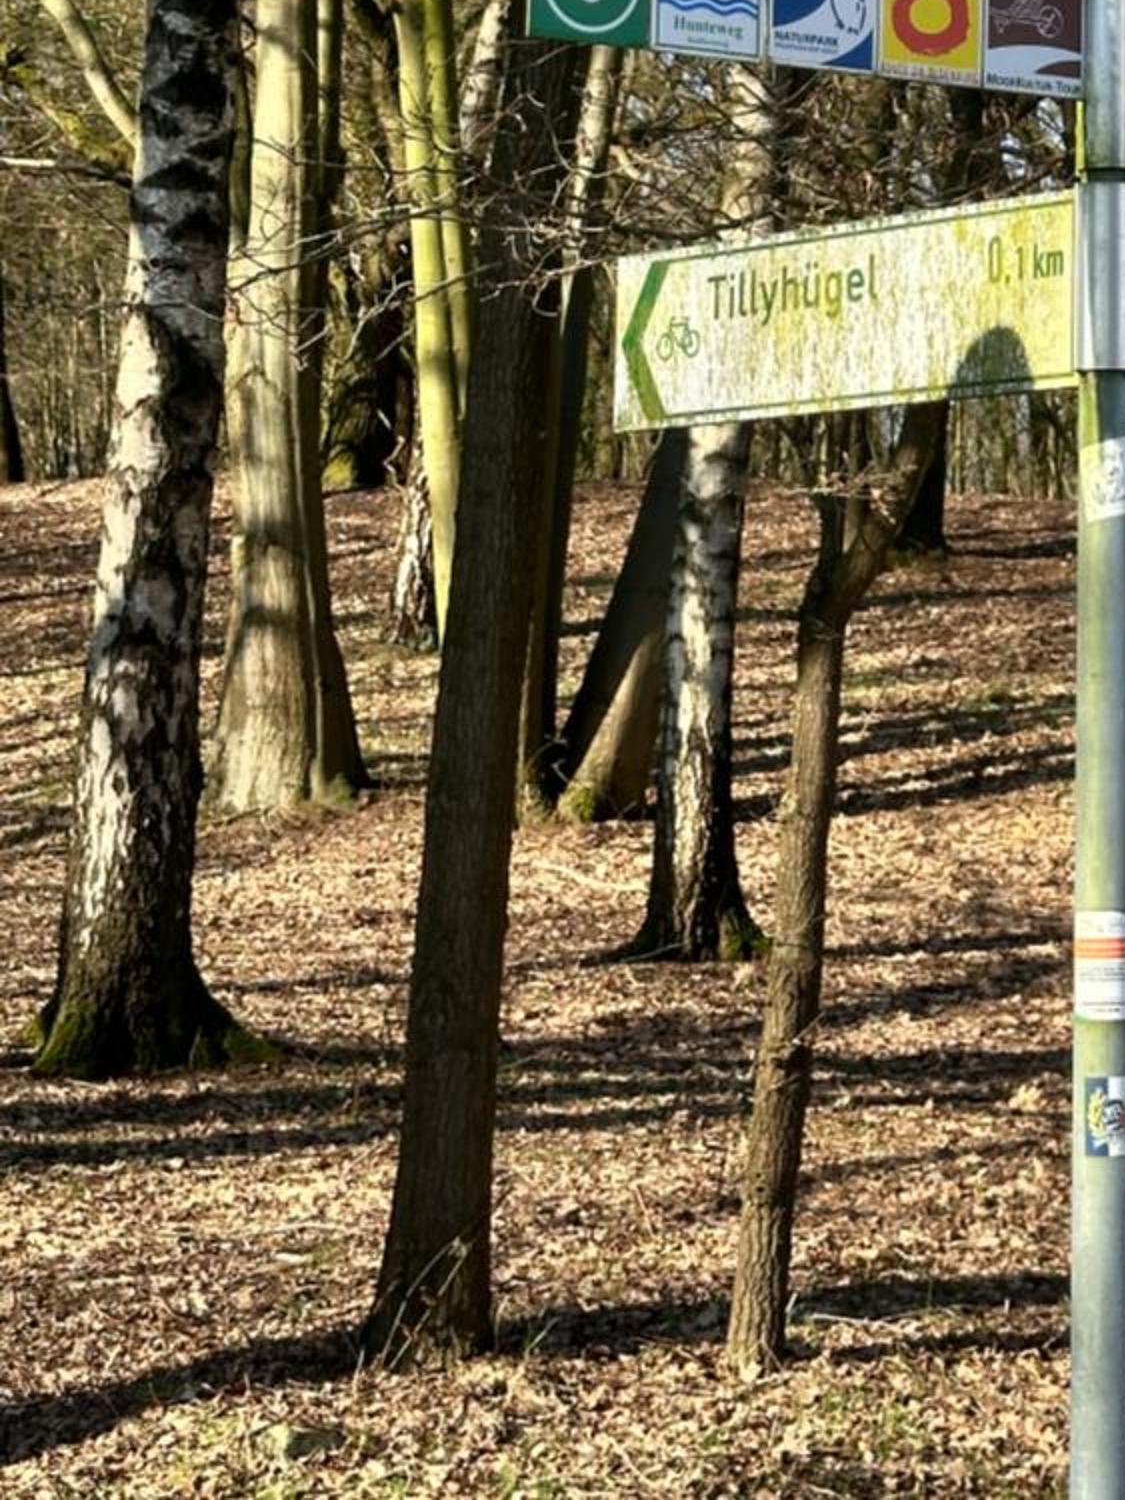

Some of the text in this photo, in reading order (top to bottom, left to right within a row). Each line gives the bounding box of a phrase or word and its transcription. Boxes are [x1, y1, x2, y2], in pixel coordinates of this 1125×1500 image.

[774, 30, 840, 47] NATURPARK
[707, 236, 1064, 326] Tillyhügel 0,1 km
